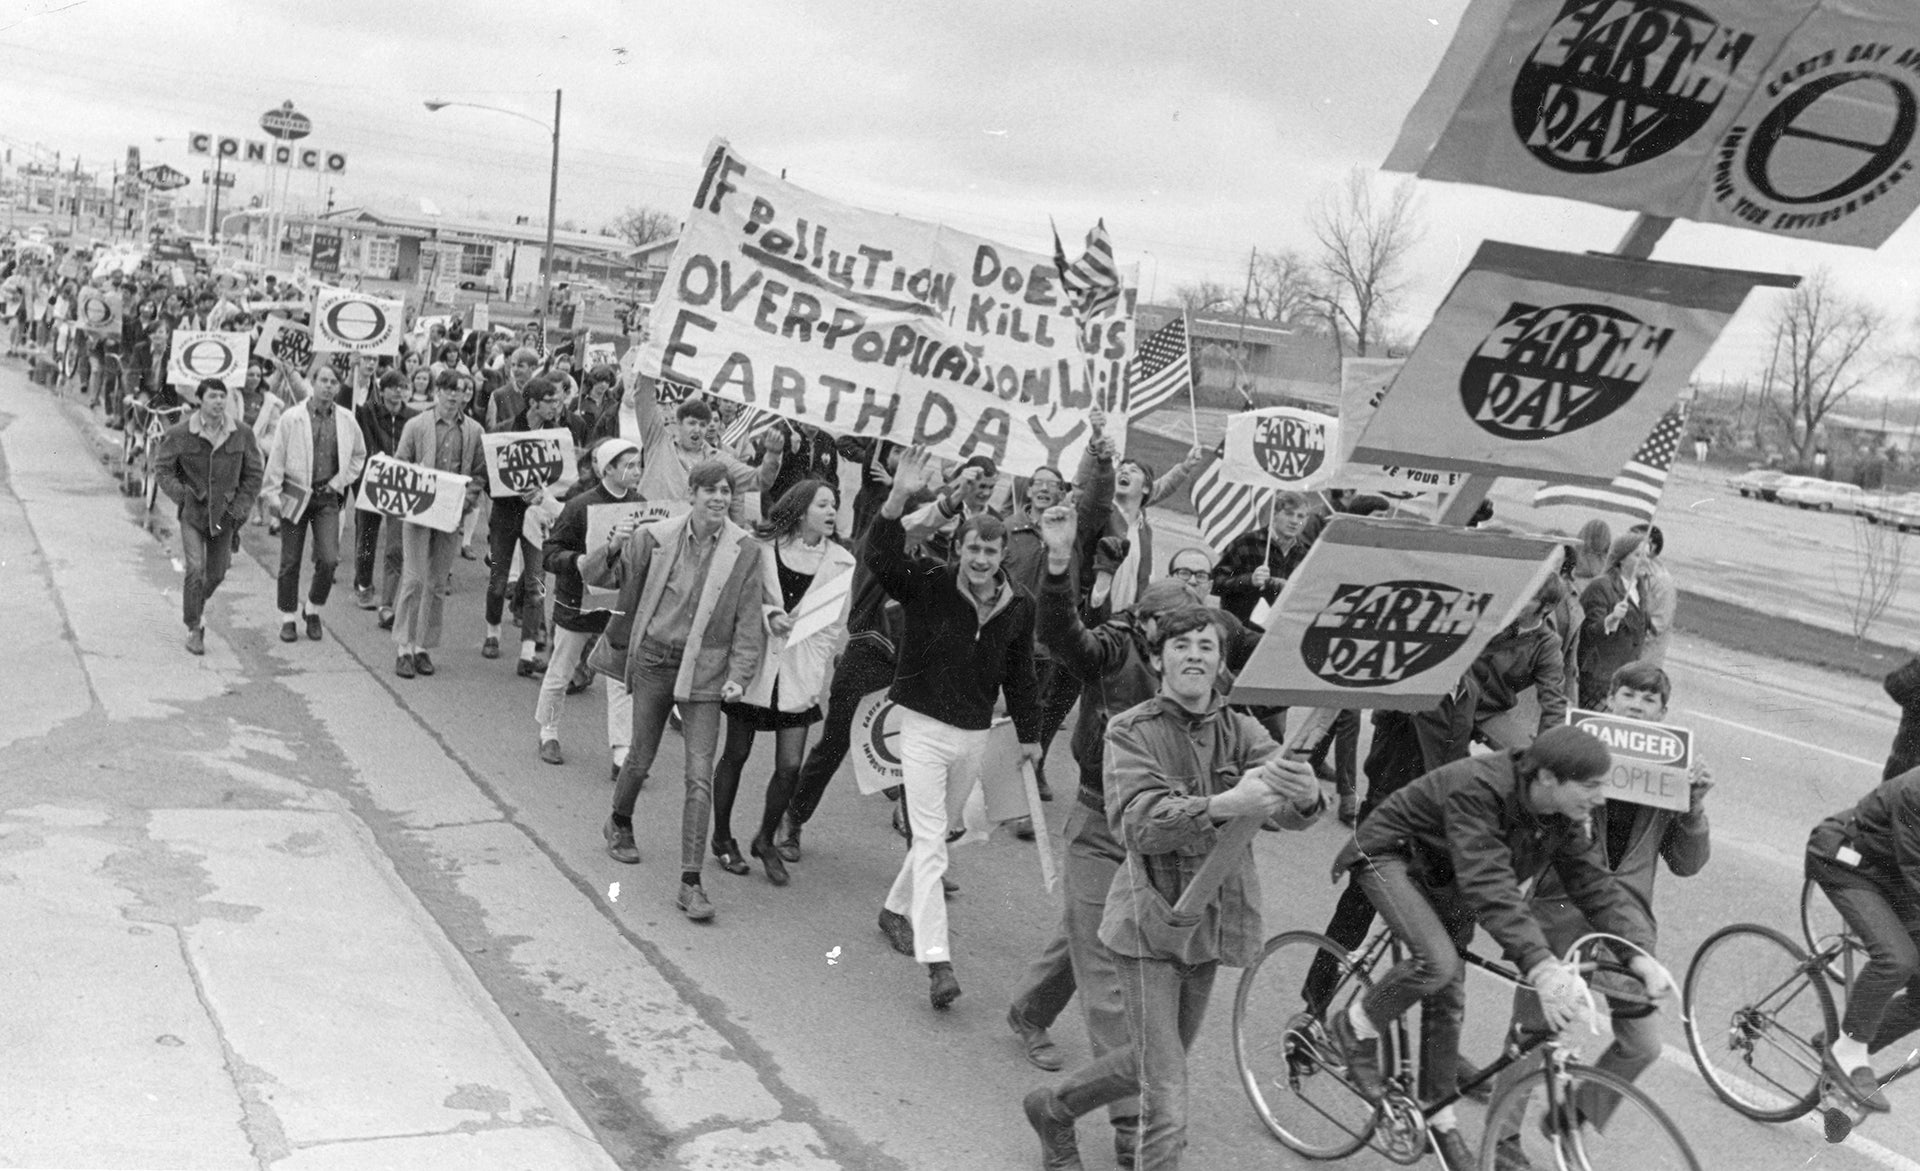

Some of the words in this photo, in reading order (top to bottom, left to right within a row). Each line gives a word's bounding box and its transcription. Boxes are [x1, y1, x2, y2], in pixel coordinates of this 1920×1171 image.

[1846, 42, 1892, 63] DAY
[263, 117, 311, 131] STANDARD
[1526, 83, 1670, 165] DAY
[192, 134, 345, 171] CONOCO
[692, 146, 747, 215] IF
[1714, 126, 1747, 202] IMPROVE
[1731, 196, 1771, 225] YOUR
[1082, 321, 1126, 360] US
[1477, 302, 1675, 383] EARTH
[660, 309, 901, 435] EARTH
[912, 389, 1088, 470] DAY
[1475, 372, 1601, 432] DAY
[1255, 416, 1324, 451] EARTH
[497, 439, 562, 469] EARTH
[1265, 448, 1311, 477] DAY
[367, 460, 437, 494] EARTH
[1407, 469, 1439, 485] YOUR
[376, 487, 420, 514] DAY
[649, 508, 670, 518] APRIL
[1314, 583, 1494, 635] EARTH
[1318, 637, 1432, 680] DAY
[862, 701, 881, 728] EARTH
[862, 742, 887, 776] IMPROVE
[1611, 765, 1675, 797] OPLE
